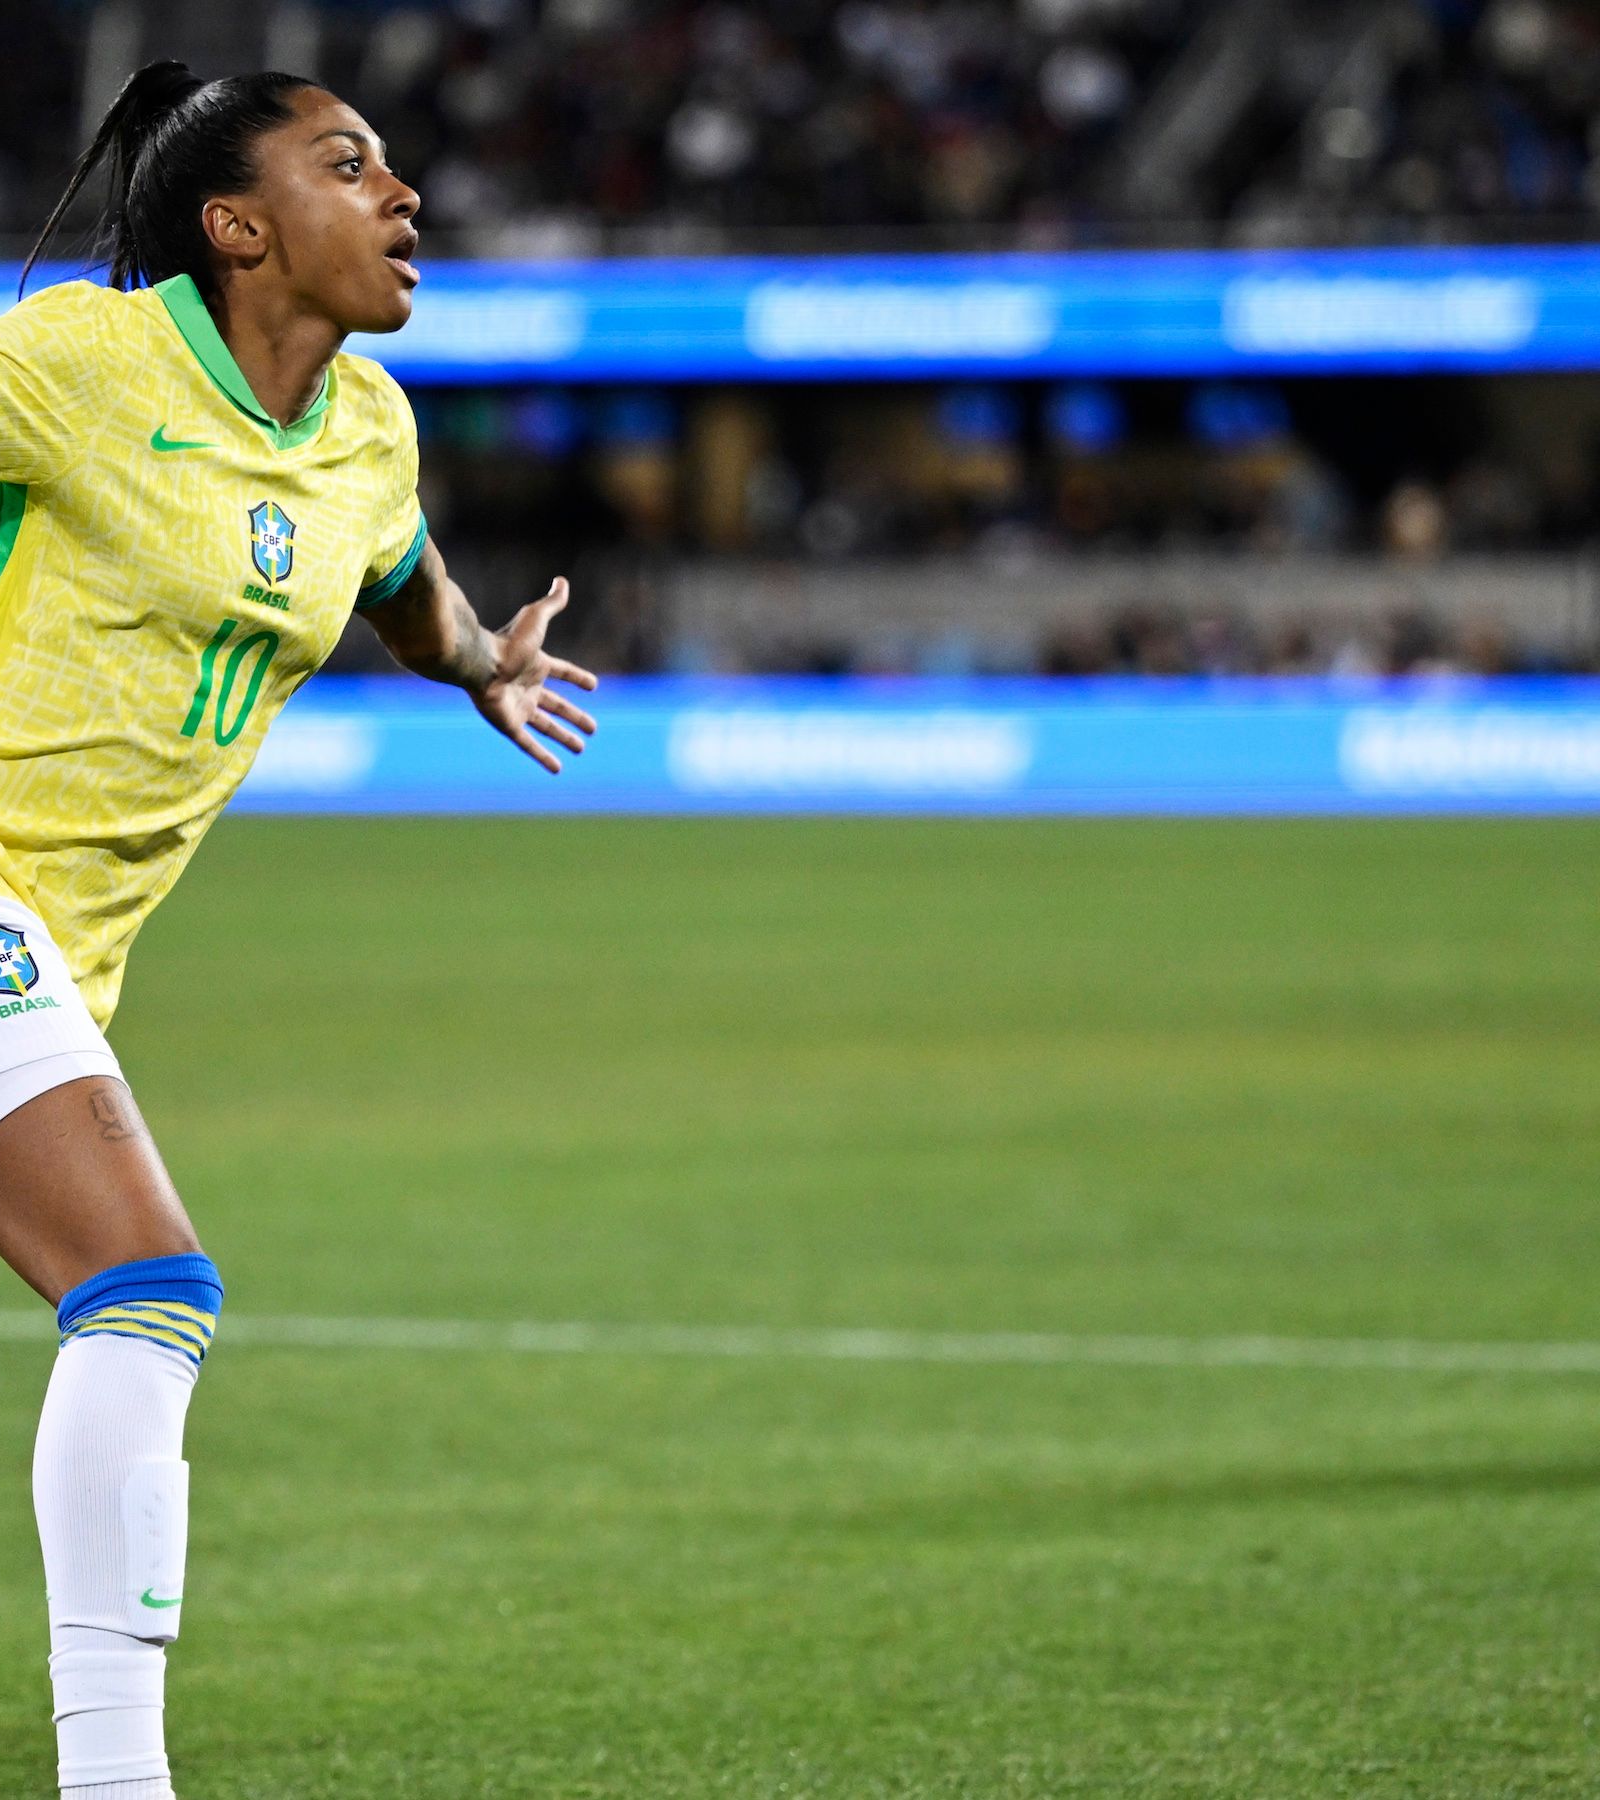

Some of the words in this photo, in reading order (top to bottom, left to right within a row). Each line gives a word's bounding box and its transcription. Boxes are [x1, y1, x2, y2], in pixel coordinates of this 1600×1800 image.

[263, 533, 281, 547] CBF
[242, 584, 290, 611] BRASIL
[180, 619, 279, 746] 10
